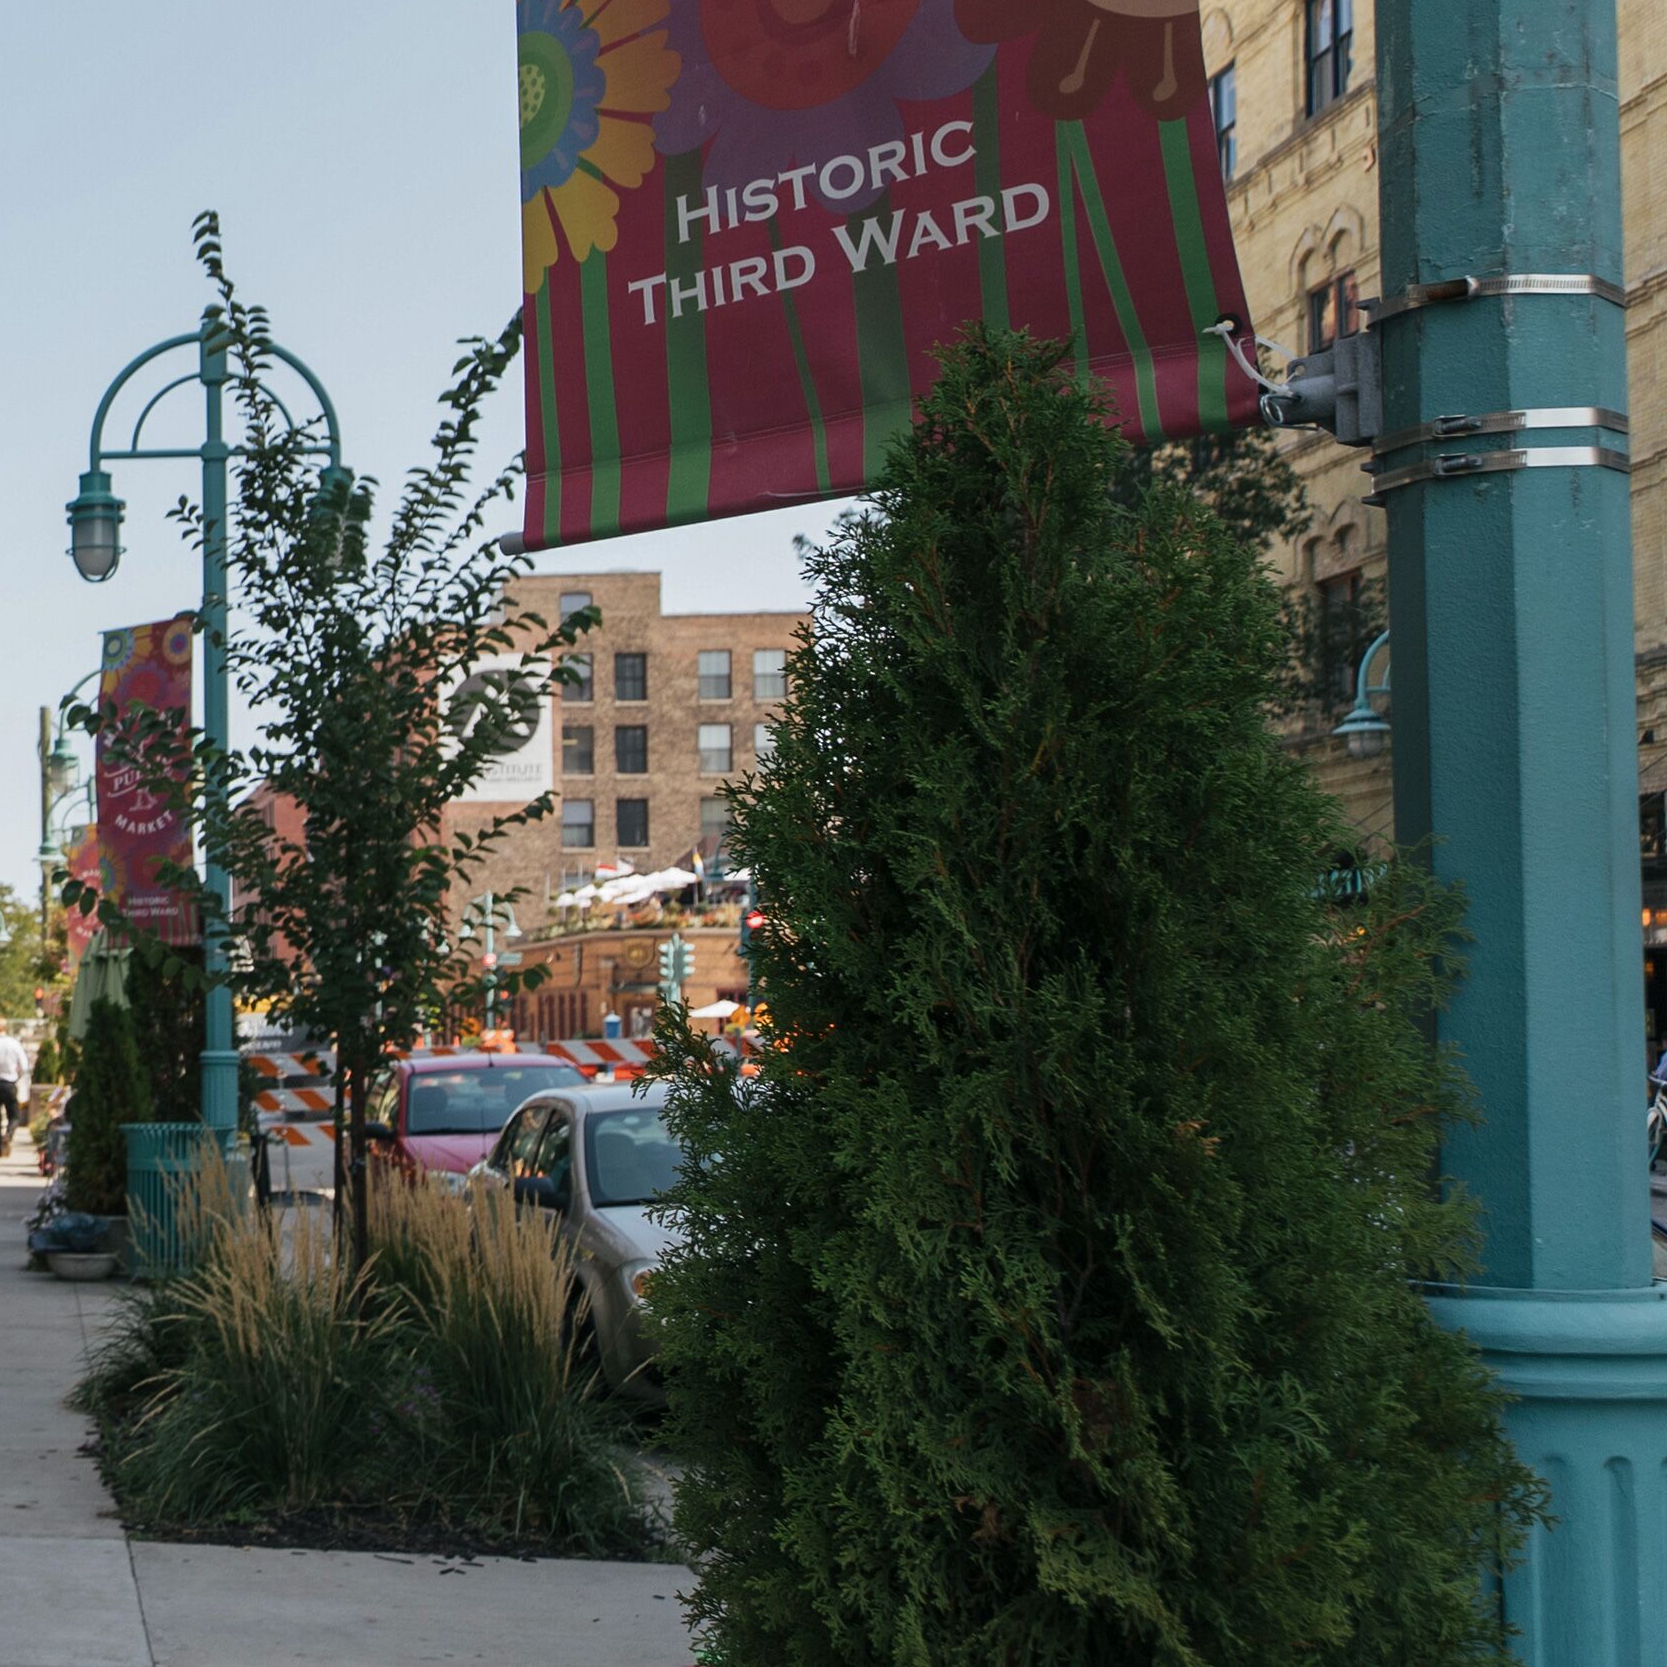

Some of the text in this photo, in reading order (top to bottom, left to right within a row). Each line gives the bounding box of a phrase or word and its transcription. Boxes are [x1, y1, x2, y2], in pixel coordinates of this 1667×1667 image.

[675, 120, 977, 244] HISTORIC
[628, 182, 1050, 326] THIRD WARD
[115, 810, 174, 835] MARKET
